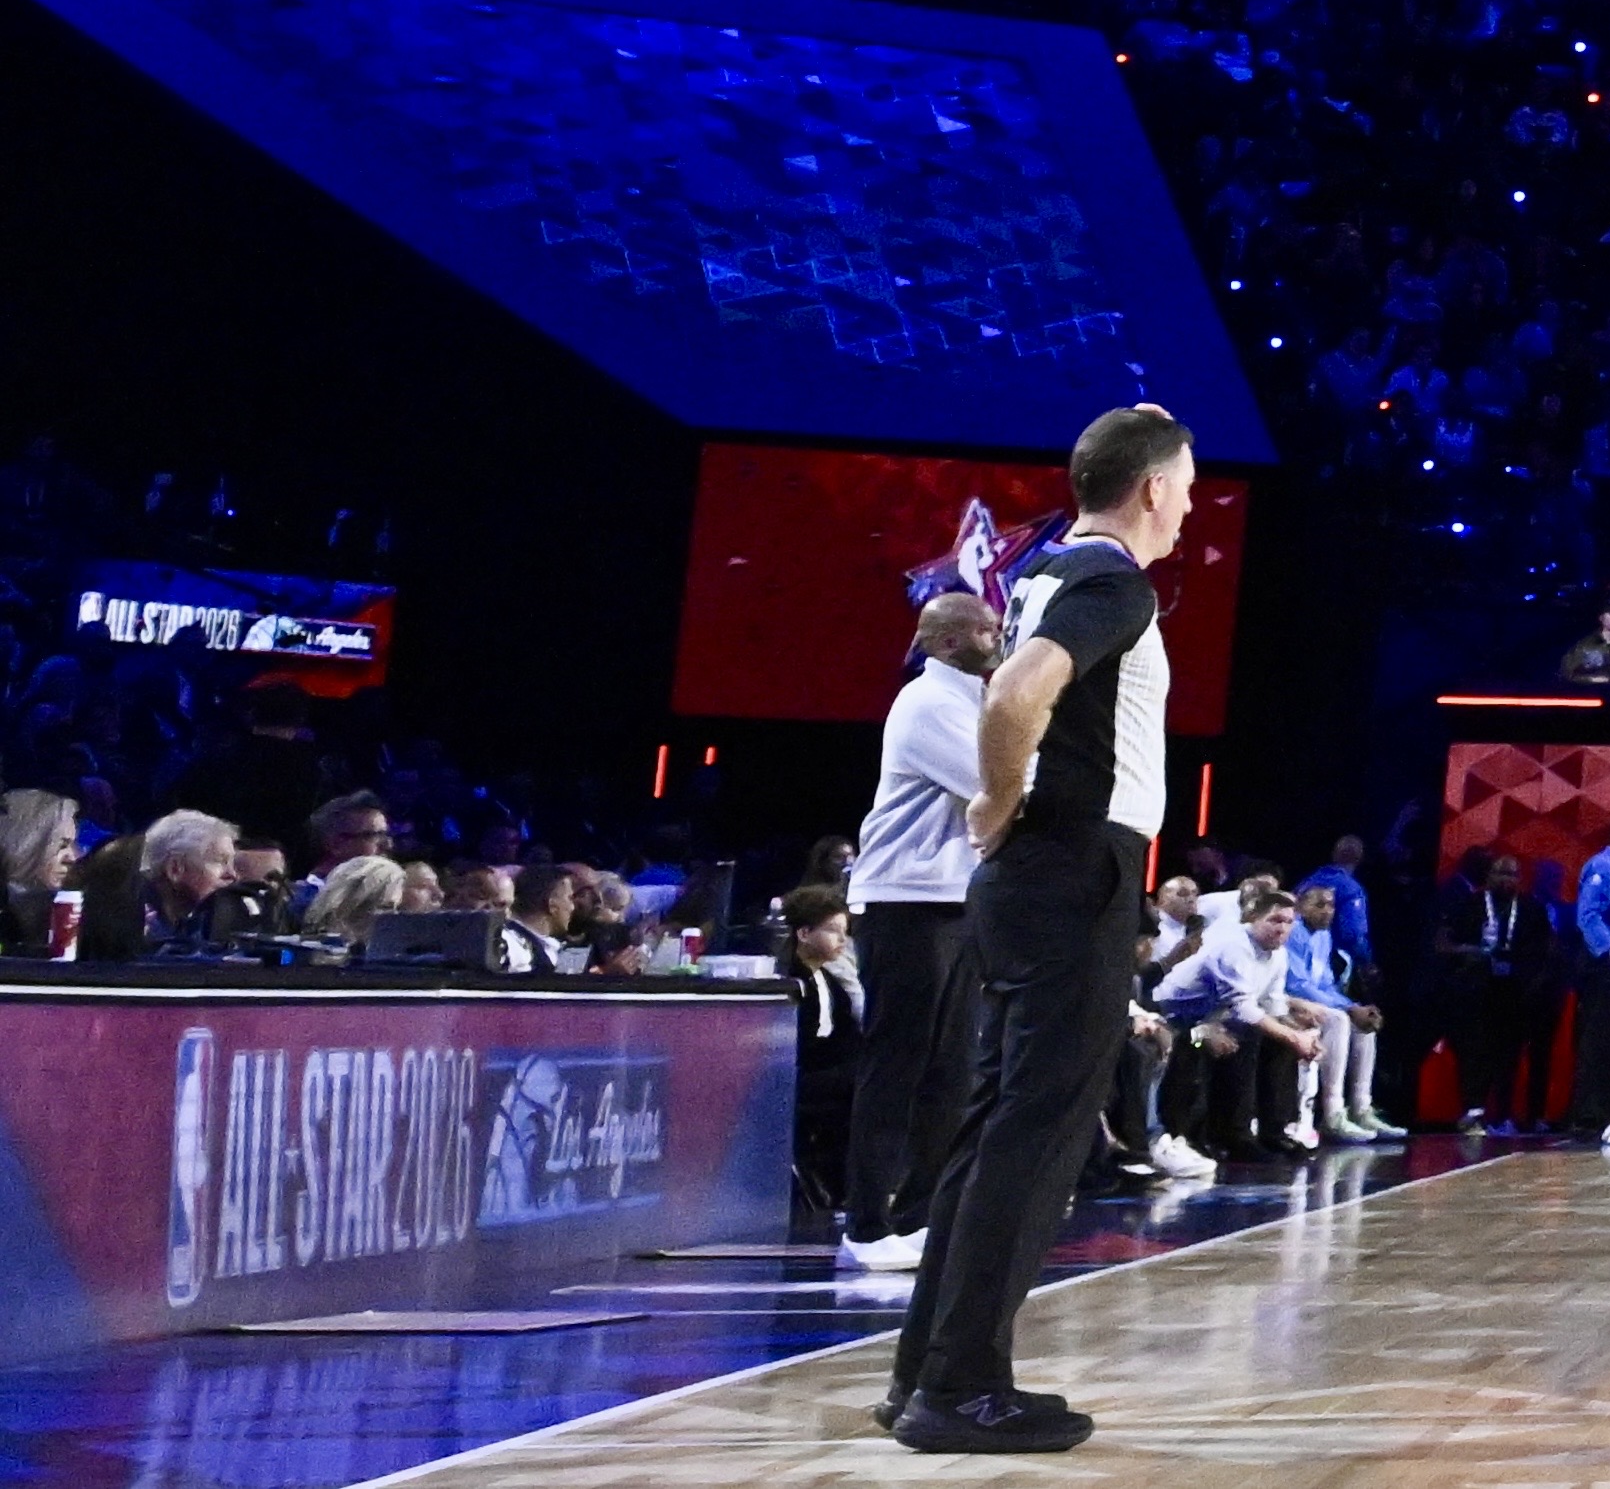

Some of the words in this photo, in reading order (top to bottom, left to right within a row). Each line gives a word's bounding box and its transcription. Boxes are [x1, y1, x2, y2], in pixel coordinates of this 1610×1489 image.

[213, 1046, 290, 1280] ALL
[297, 1046, 397, 1268] STAR
[395, 1046, 476, 1250] 2026
